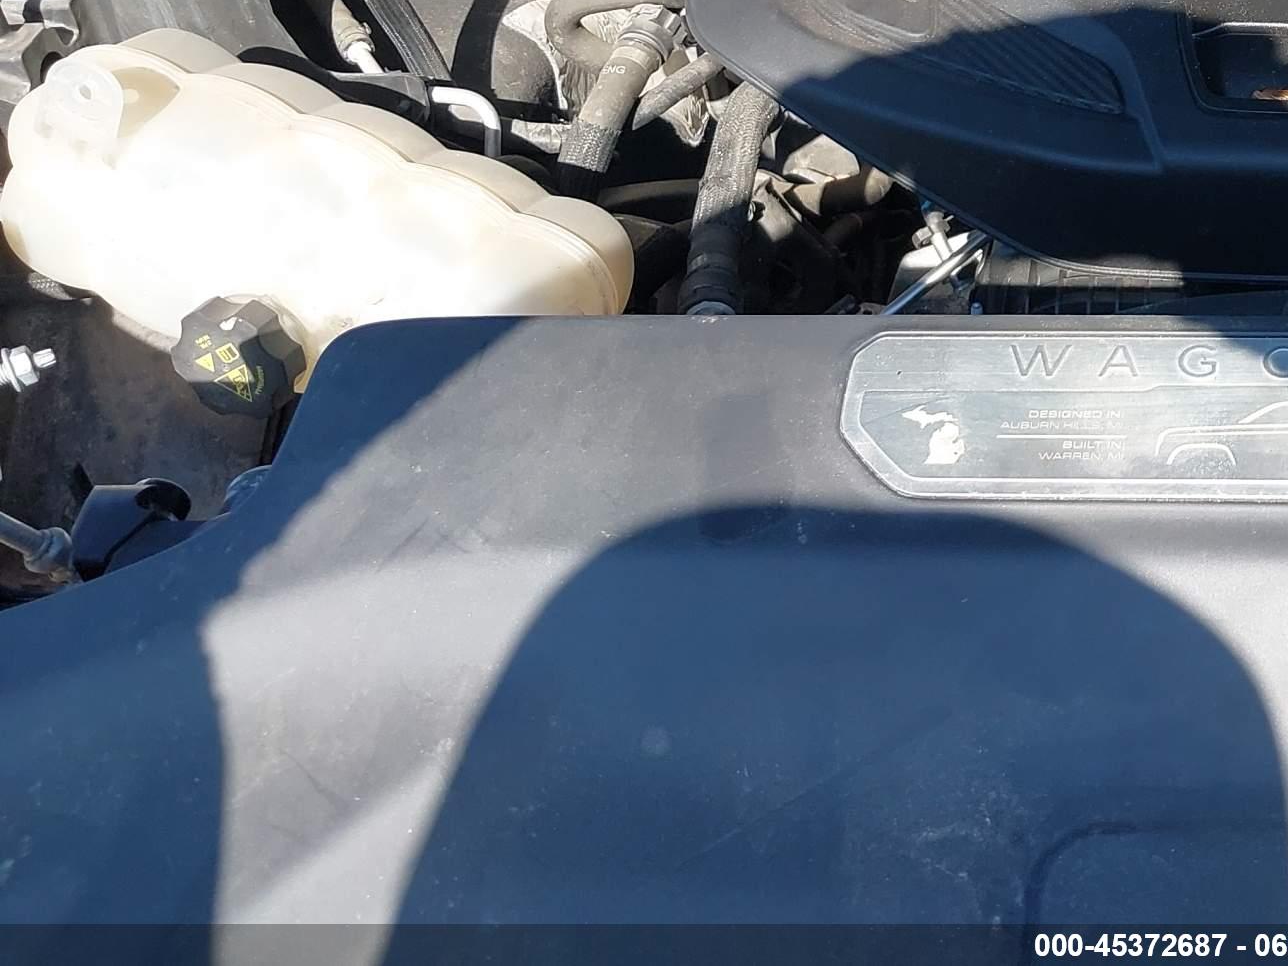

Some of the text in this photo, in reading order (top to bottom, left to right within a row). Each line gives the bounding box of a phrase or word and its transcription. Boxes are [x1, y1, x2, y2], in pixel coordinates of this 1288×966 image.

[1028, 409, 1122, 419] DESIGNED IN
[1000, 420, 1060, 430] AUBURN
[1062, 440, 1122, 449] BUILT IN
